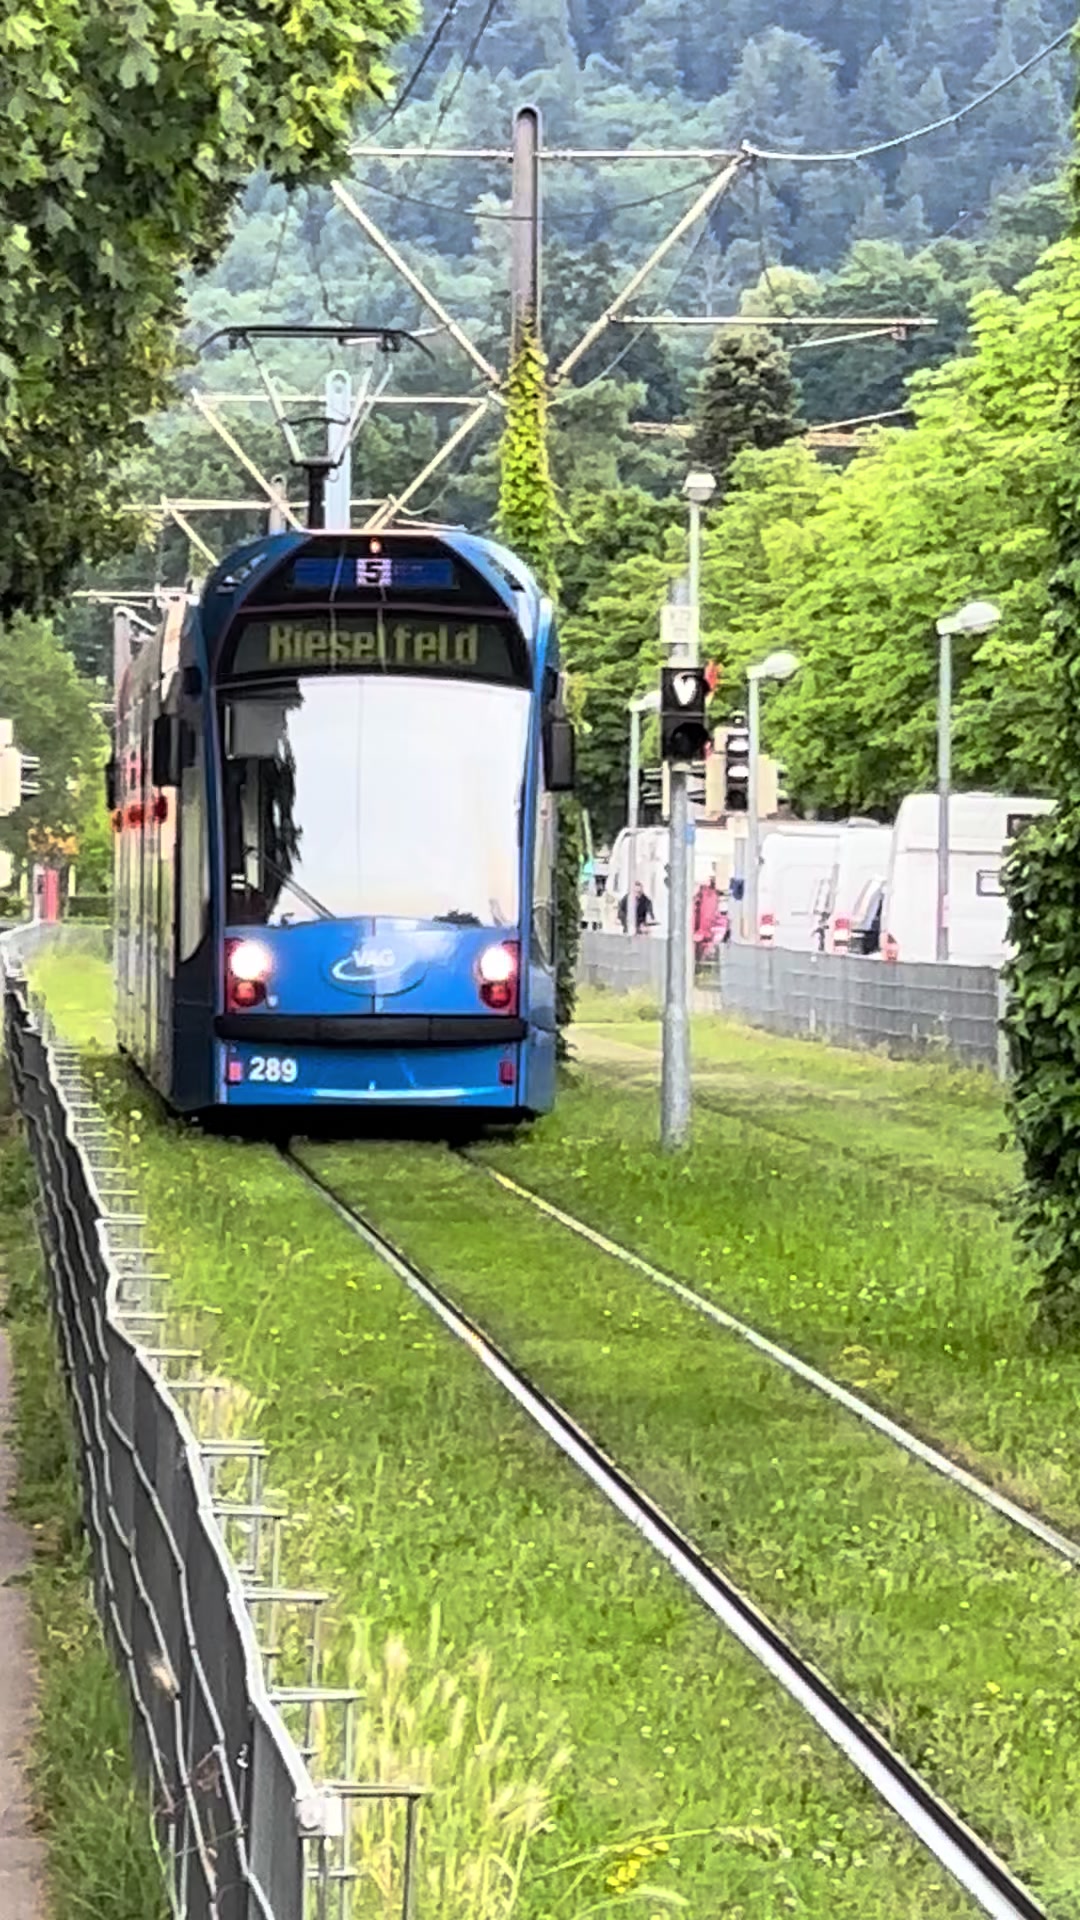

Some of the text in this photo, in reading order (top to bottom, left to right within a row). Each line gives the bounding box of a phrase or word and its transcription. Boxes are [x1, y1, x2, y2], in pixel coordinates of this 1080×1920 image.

[363, 560, 386, 585] 5
[269, 624, 478, 665] Rieselfeld
[352, 949, 396, 967] VAG
[249, 1056, 298, 1082] 289
